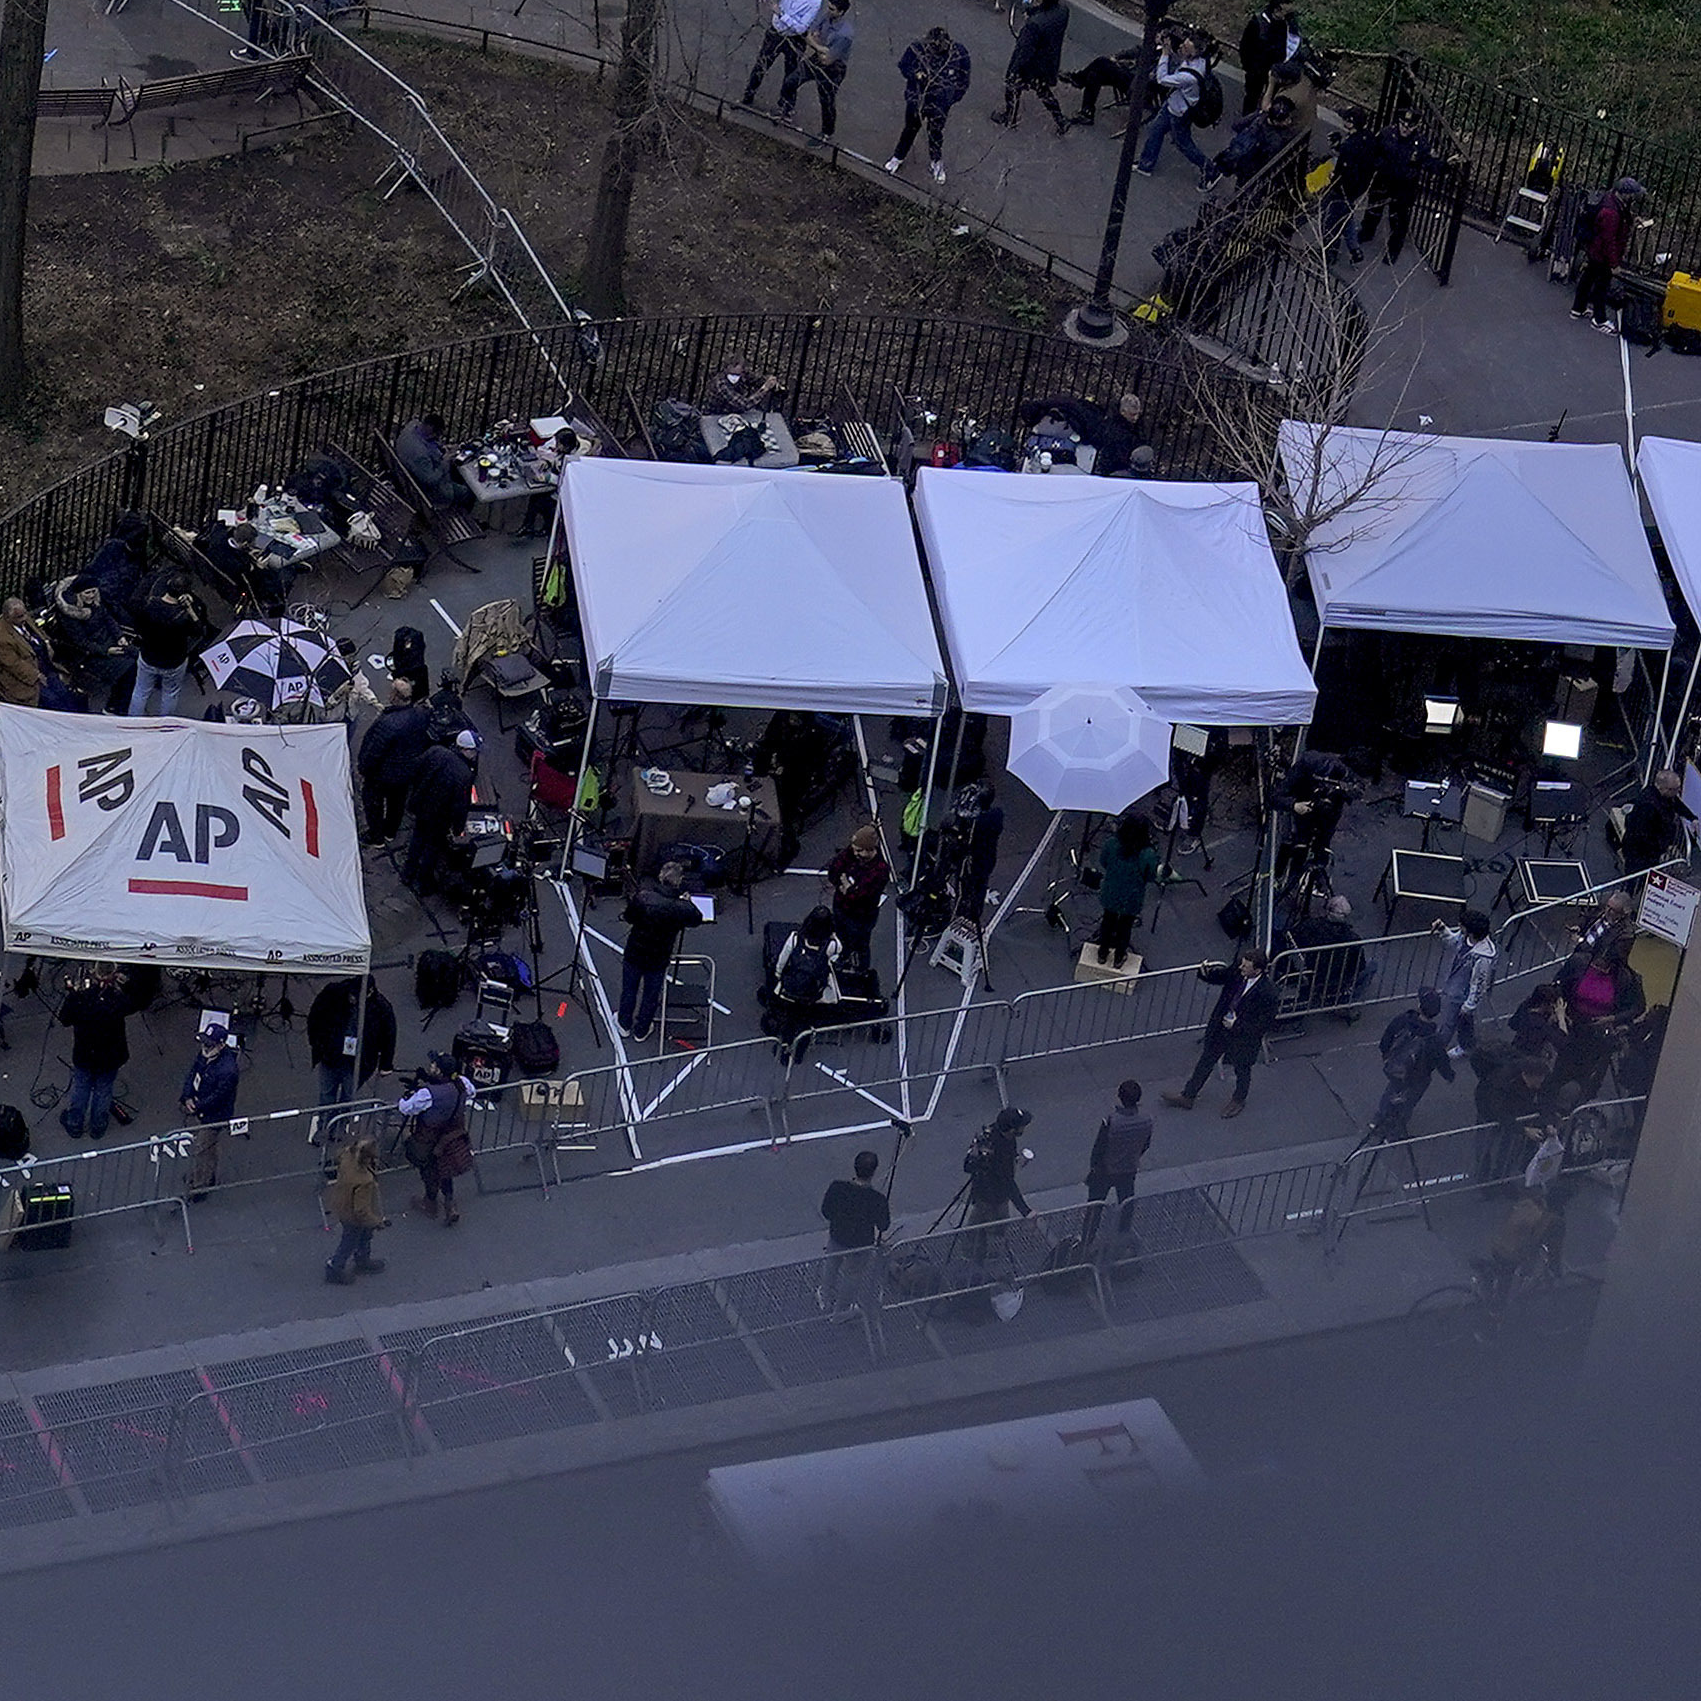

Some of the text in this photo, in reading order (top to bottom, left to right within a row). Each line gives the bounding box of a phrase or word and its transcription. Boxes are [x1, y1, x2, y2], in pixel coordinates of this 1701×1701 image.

[288, 681, 303, 694] AP
[78, 748, 135, 811] AP
[242, 747, 291, 838] AP
[136, 802, 240, 863] AP
[14, 932, 32, 944] AP
[140, 942, 157, 952] AP
[267, 949, 283, 961] AP
[230, 1121, 248, 1134] AP
